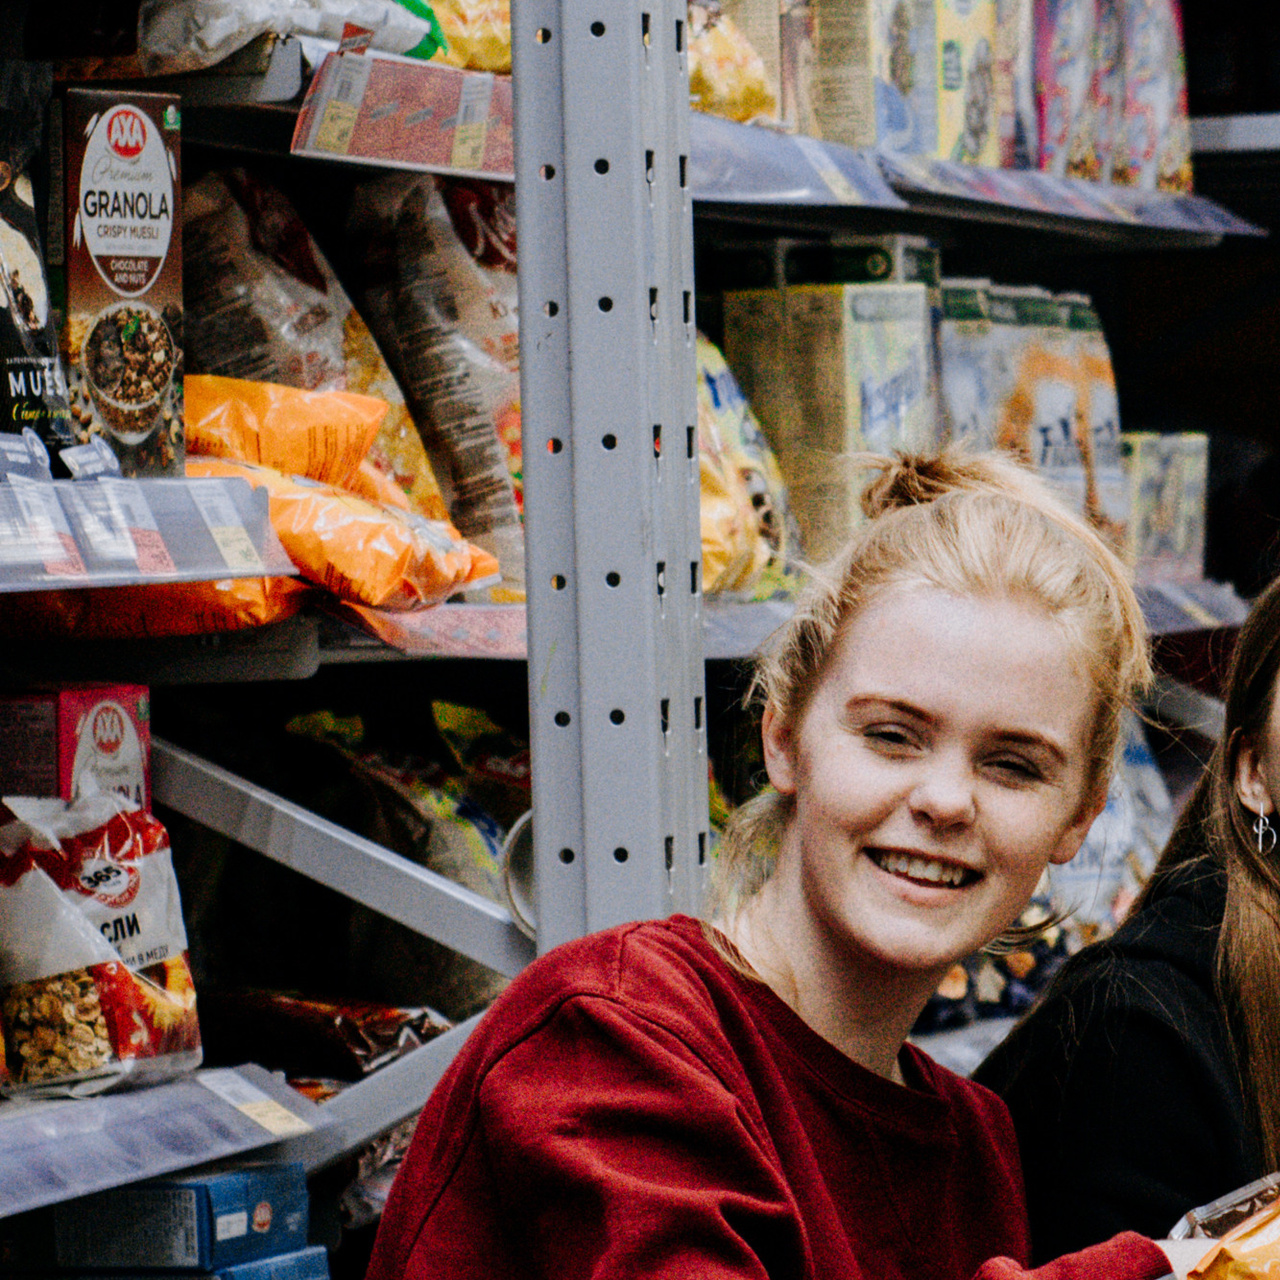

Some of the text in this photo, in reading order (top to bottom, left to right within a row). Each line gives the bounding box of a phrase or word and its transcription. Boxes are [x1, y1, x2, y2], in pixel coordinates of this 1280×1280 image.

[83, 189, 170, 220] GRANOLA
[96, 223, 159, 241] CRISPY MUESLI
[110, 258, 149, 272] CHOCOLATE
[80, 866, 122, 889] 365
